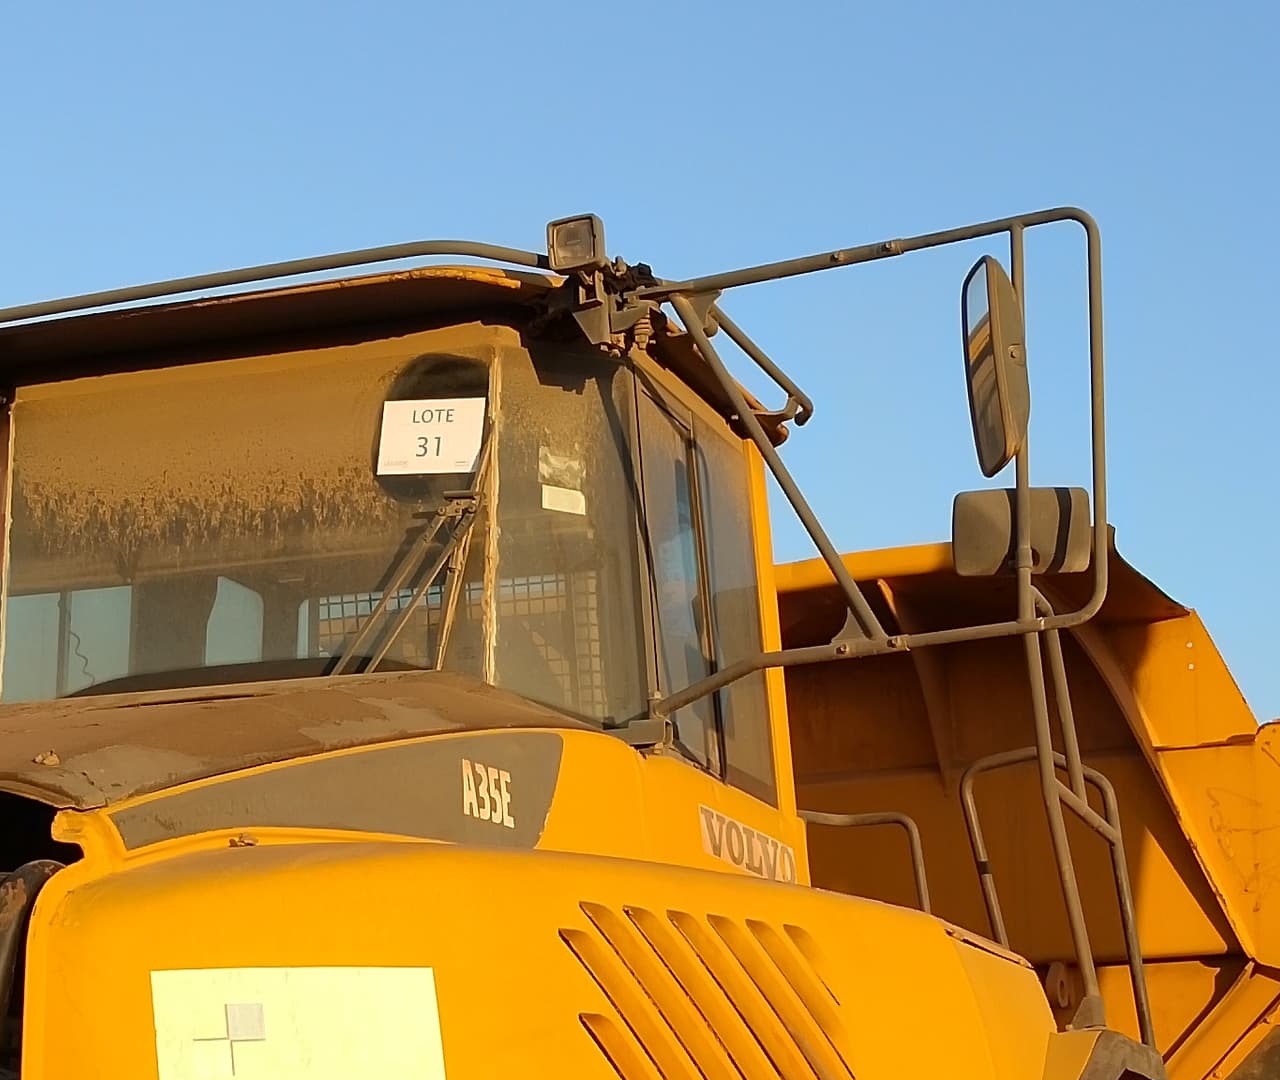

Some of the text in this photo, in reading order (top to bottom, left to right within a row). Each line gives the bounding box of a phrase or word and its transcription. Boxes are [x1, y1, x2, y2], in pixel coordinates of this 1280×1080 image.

[412, 409, 455, 424] LOTE
[415, 436, 443, 457] 31
[461, 759, 515, 829] A35E
[699, 806, 796, 884] VOLVO
